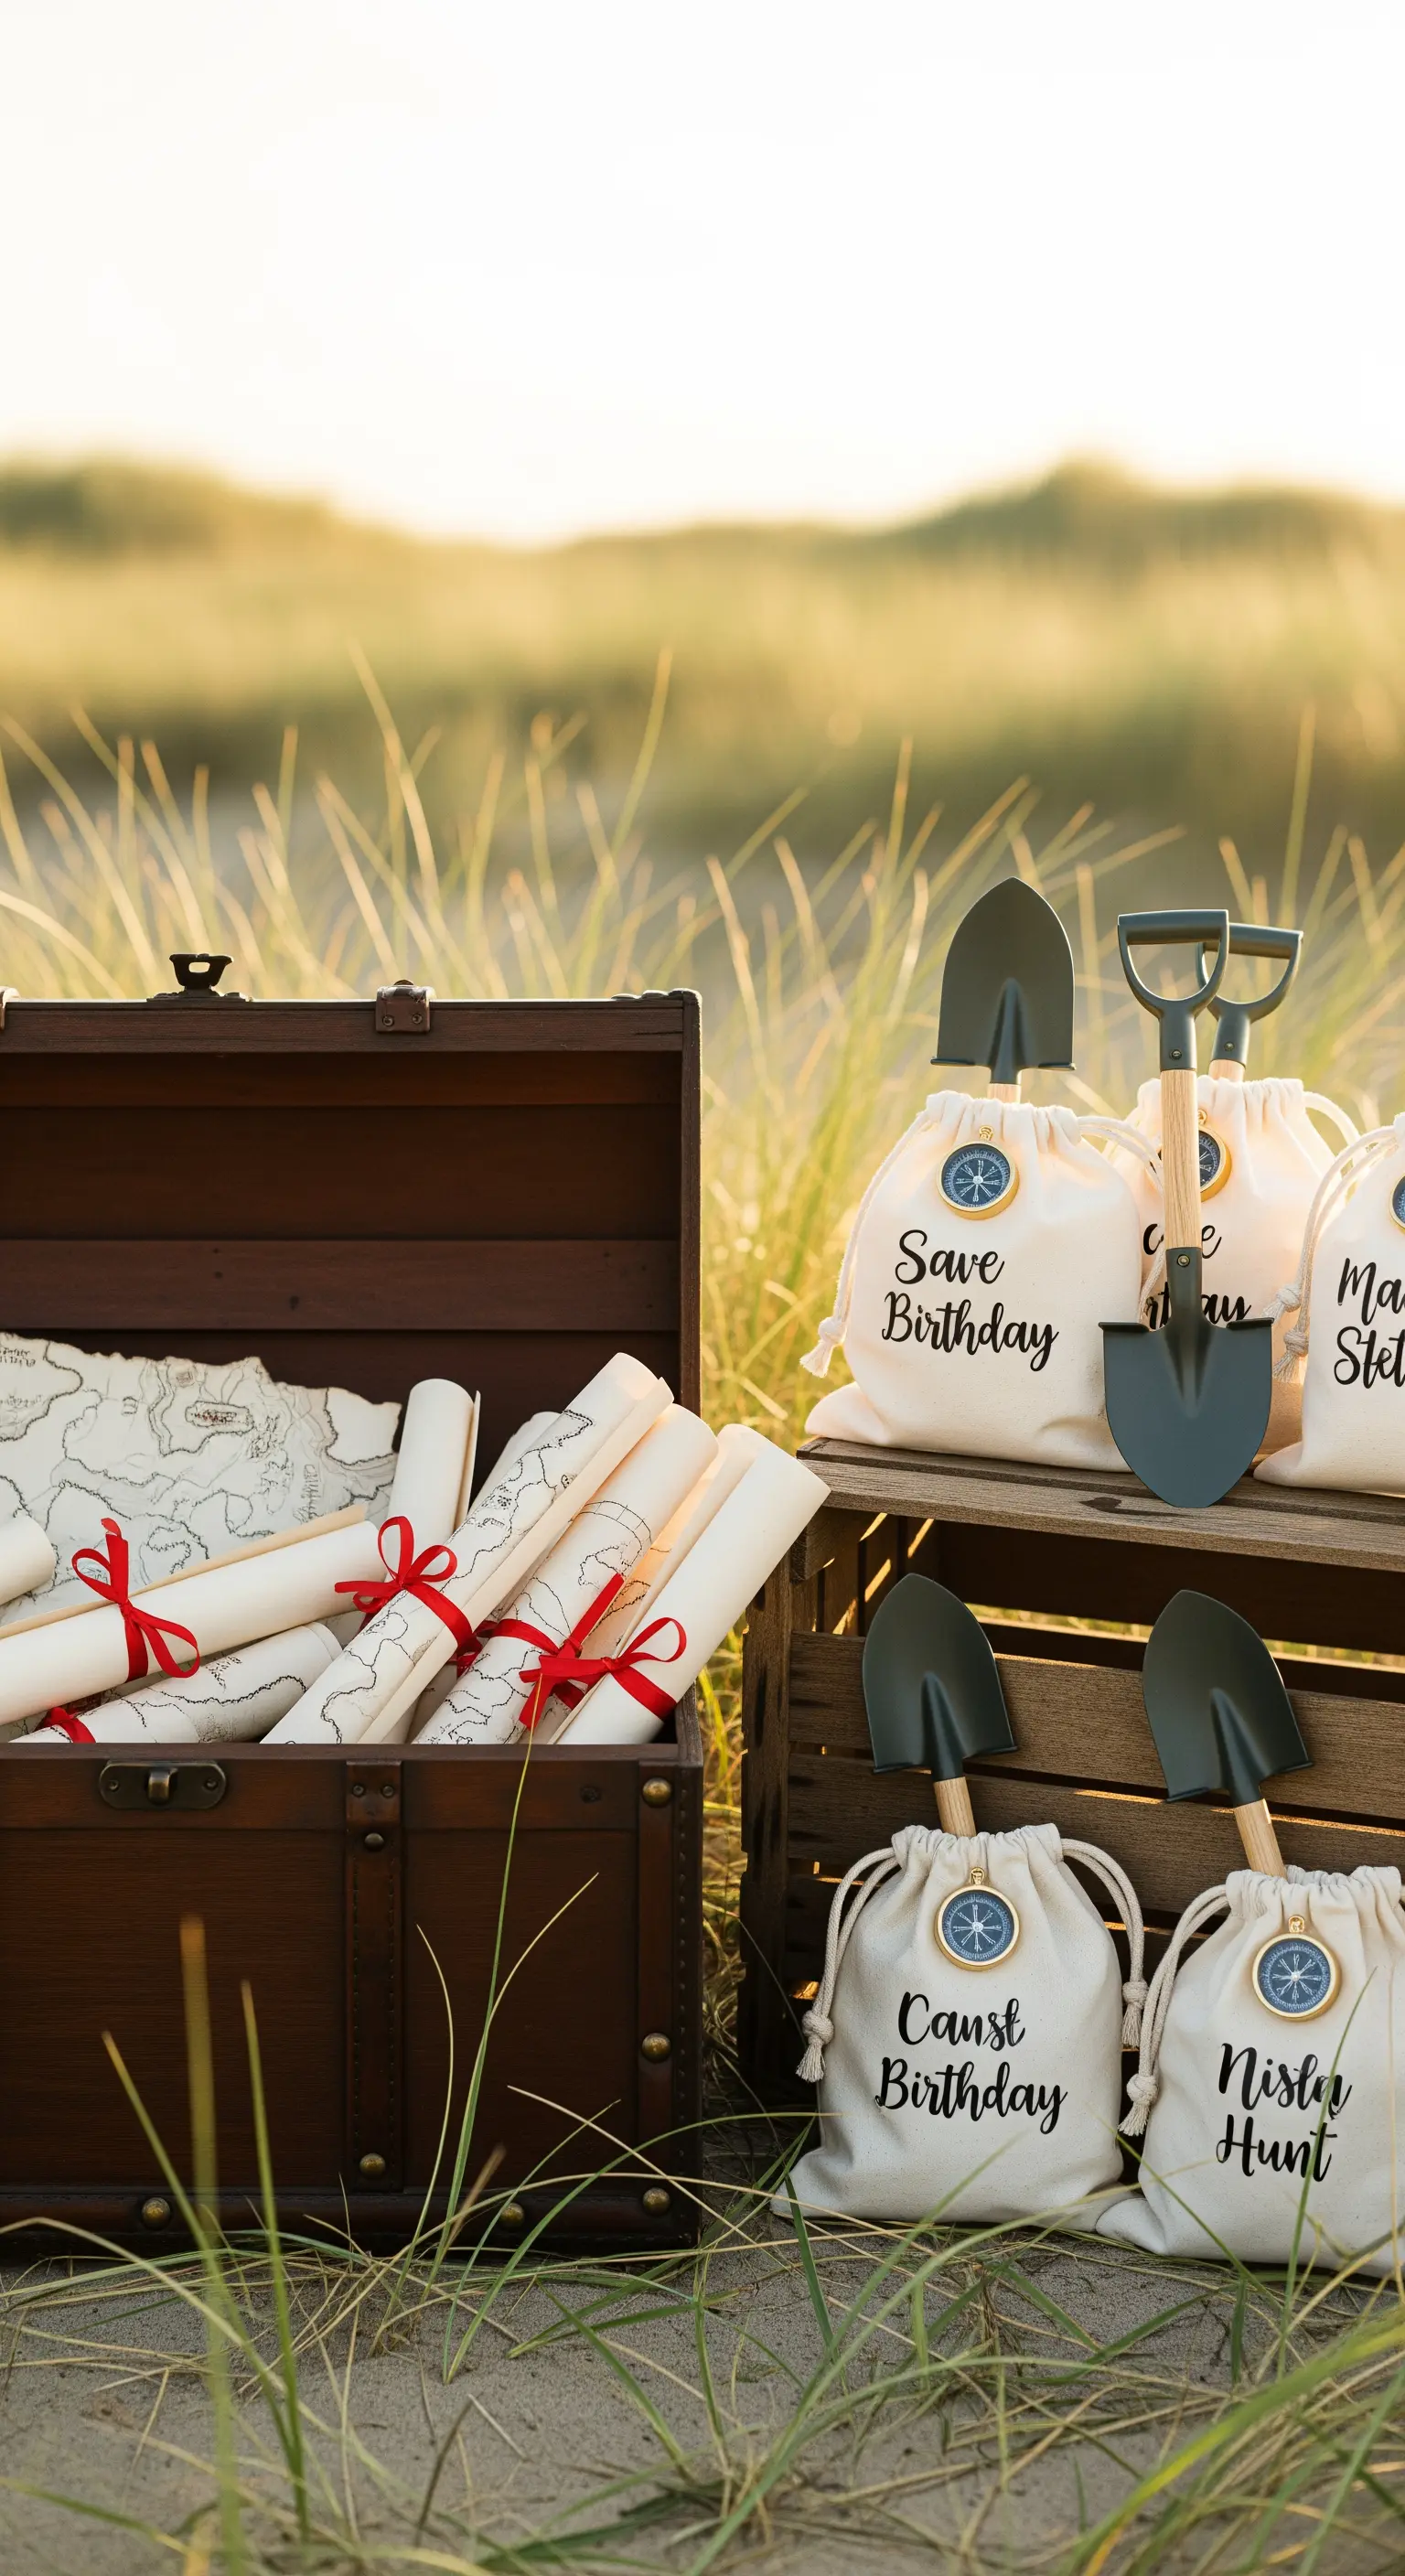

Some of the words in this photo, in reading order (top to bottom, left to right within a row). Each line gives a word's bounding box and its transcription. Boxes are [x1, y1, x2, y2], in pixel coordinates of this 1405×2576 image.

[895, 1229, 1005, 1285] Save
[881, 1291, 1060, 1373] Birthday
[874, 2056, 1068, 2135] Birthday
[1216, 2113, 1338, 2183] Hunt
